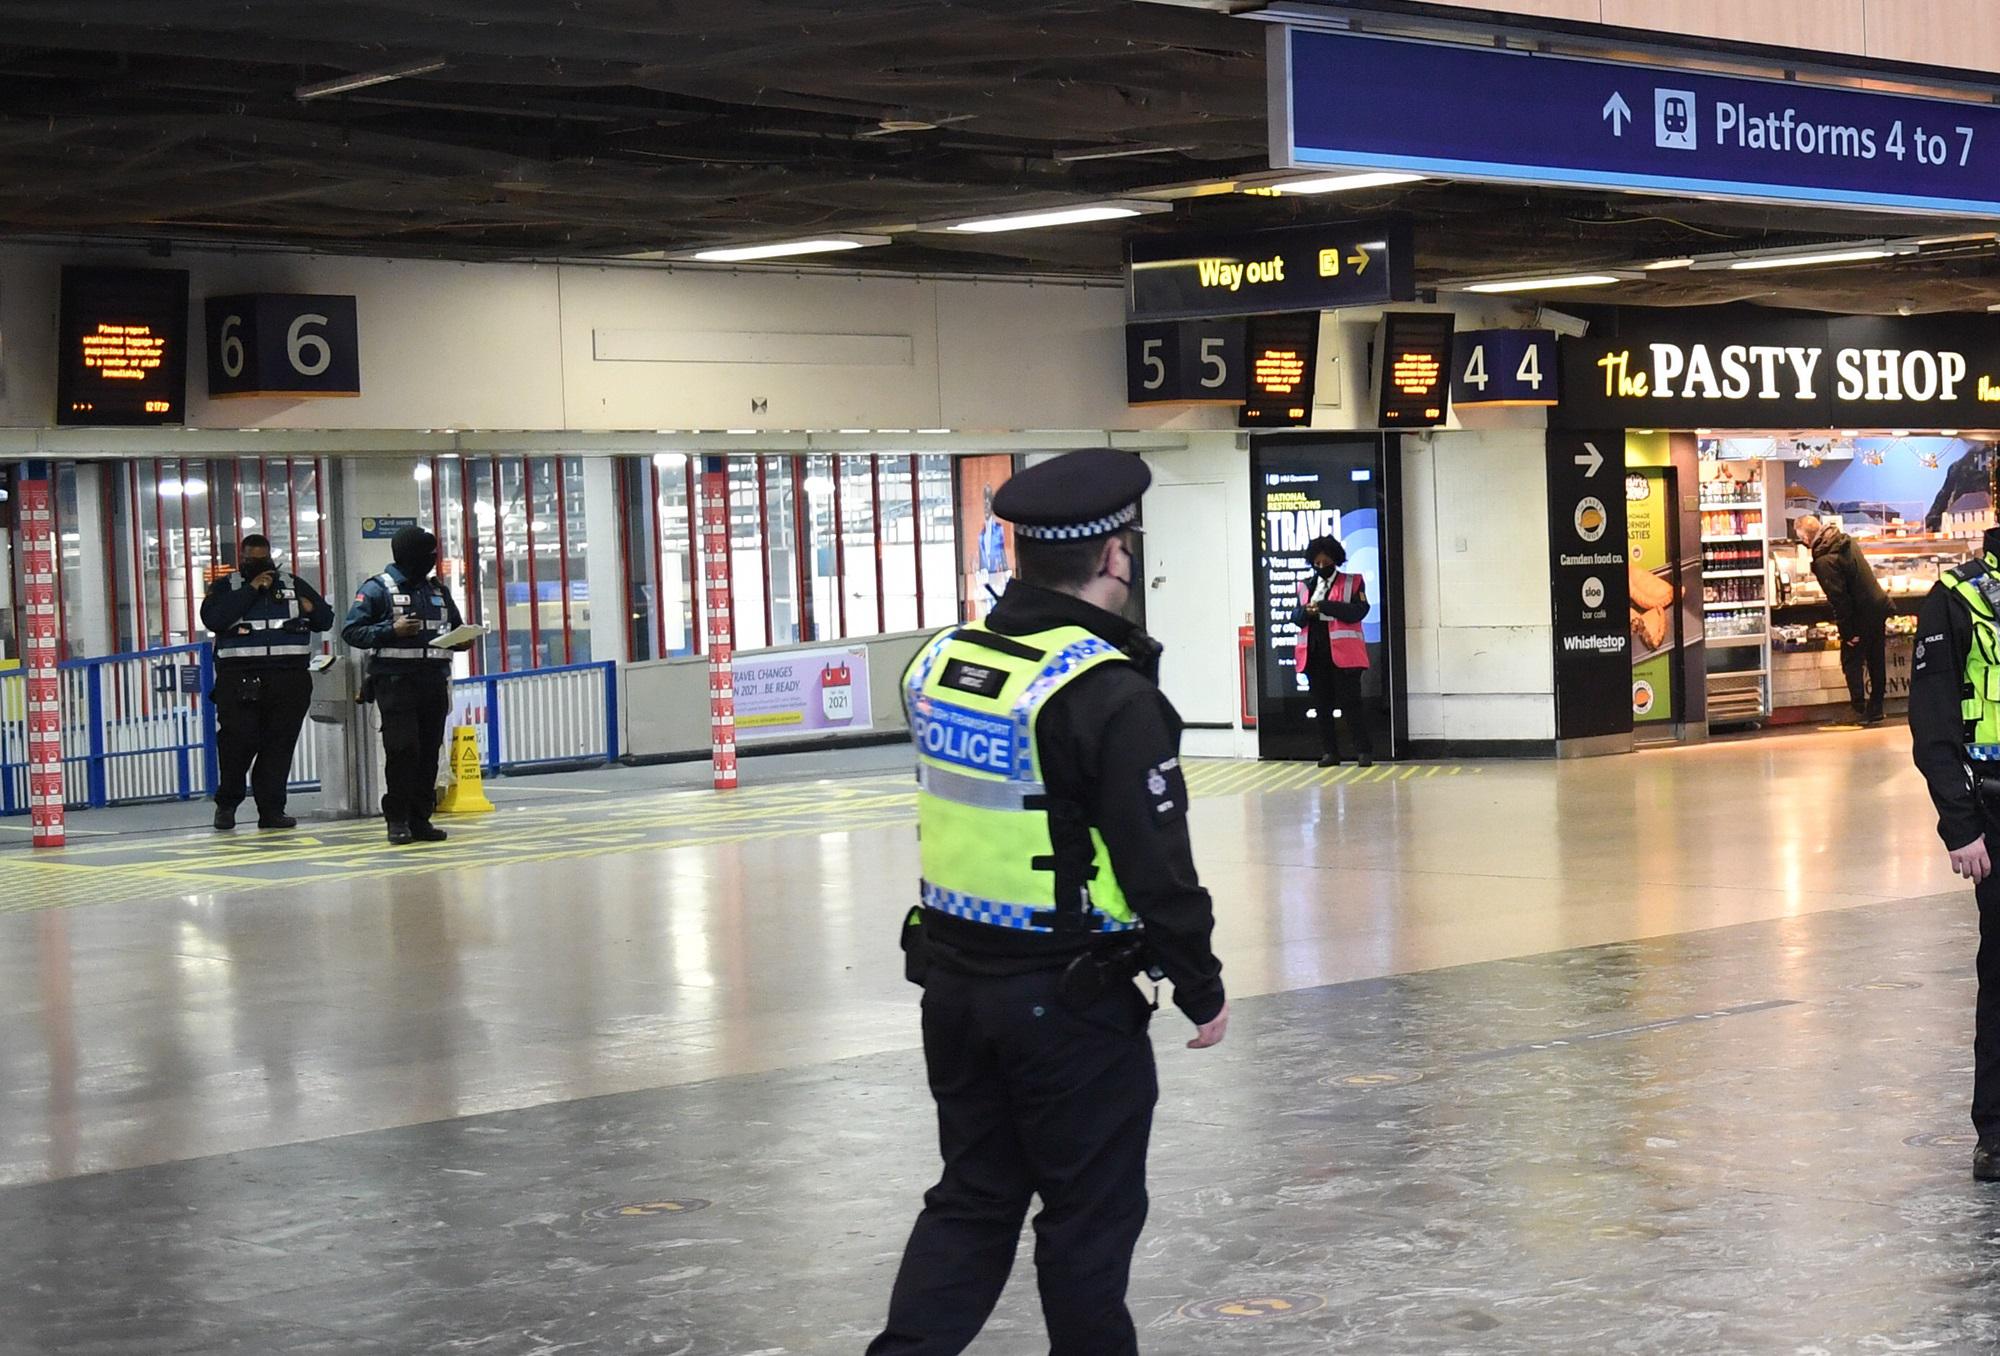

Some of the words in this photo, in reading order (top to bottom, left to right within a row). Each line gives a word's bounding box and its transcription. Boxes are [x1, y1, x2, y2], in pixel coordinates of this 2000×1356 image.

[1715, 101, 1876, 159] Platforms
[1885, 120, 1906, 161] 4
[1914, 126, 1947, 165] to
[1955, 126, 1974, 167] 7
[1198, 258, 1243, 291] Way
[1246, 255, 1285, 284] out
[221, 315, 244, 378] 6
[287, 313, 332, 376] 6
[1143, 338, 1165, 389] 5
[1200, 337, 1227, 388] 5
[1463, 345, 1489, 391] 4
[1516, 344, 1543, 390] 4
[1649, 343, 1822, 400] PASTY
[1836, 347, 1966, 401] SHOP
[1267, 492, 1307, 502] NATIONAL
[1267, 500, 1321, 511] RESTRICTIONS
[1269, 557, 1287, 568] You
[1560, 553, 1594, 566] Camden
[1594, 552, 1612, 564] food
[1613, 554, 1624, 564] co.
[1585, 587, 1602, 597] sloe
[1582, 610, 1593, 619] bar
[1564, 634, 1626, 652] Whistlestop
[757, 665, 793, 680] CHANGES
[1893, 652, 1905, 667] in
[828, 696, 848, 709] 2021
[914, 717, 1010, 769] POLICE
